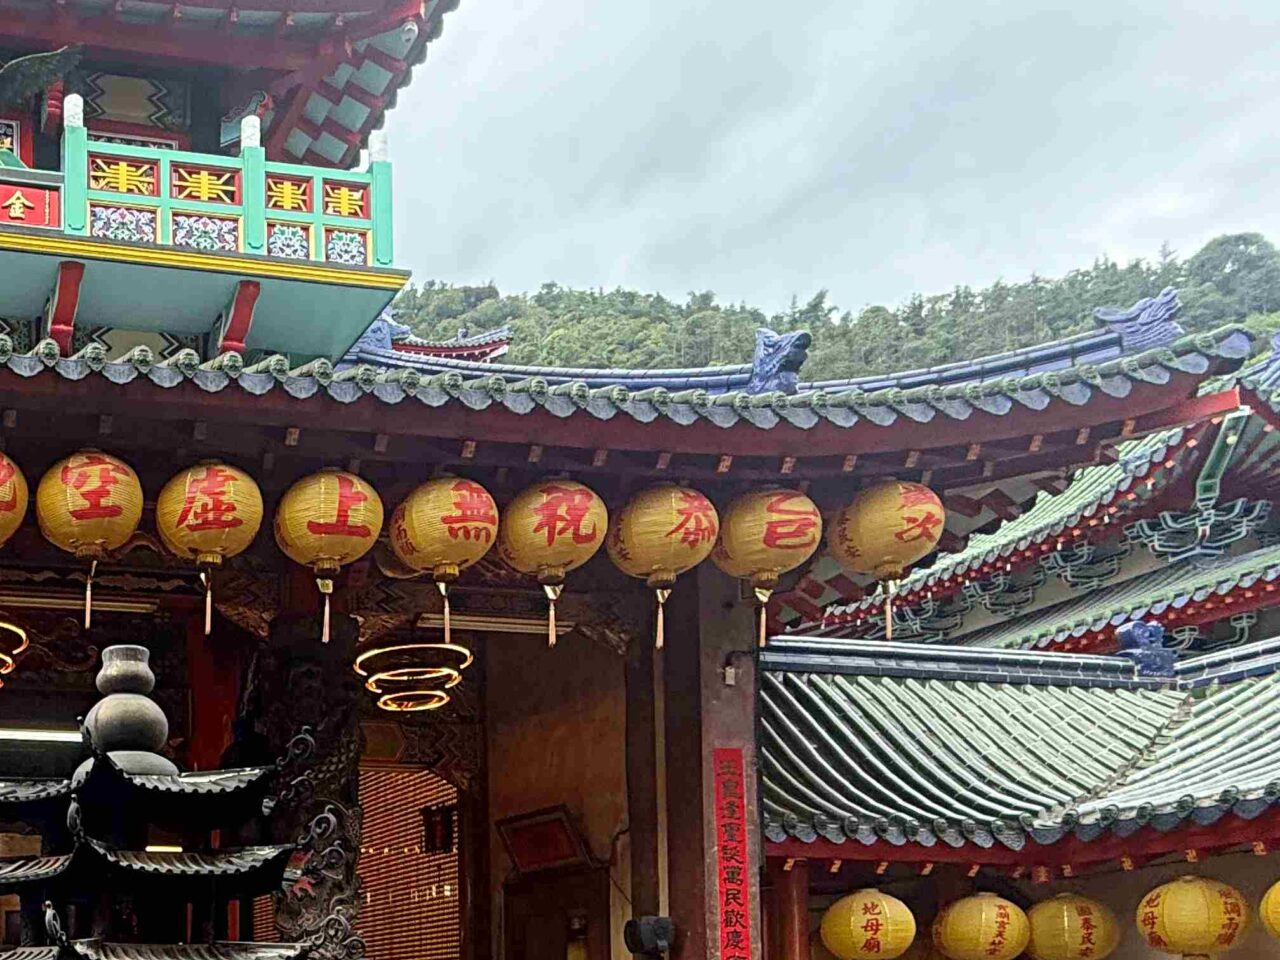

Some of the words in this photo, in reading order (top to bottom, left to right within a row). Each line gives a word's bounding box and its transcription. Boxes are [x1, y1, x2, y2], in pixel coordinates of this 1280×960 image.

[61, 455, 130, 520] 空
[307, 474, 371, 537] 上
[441, 481, 498, 543] 無
[534, 485, 600, 545] 祝
[666, 490, 718, 548] 恭
[860, 901, 883, 953] 地母廟
